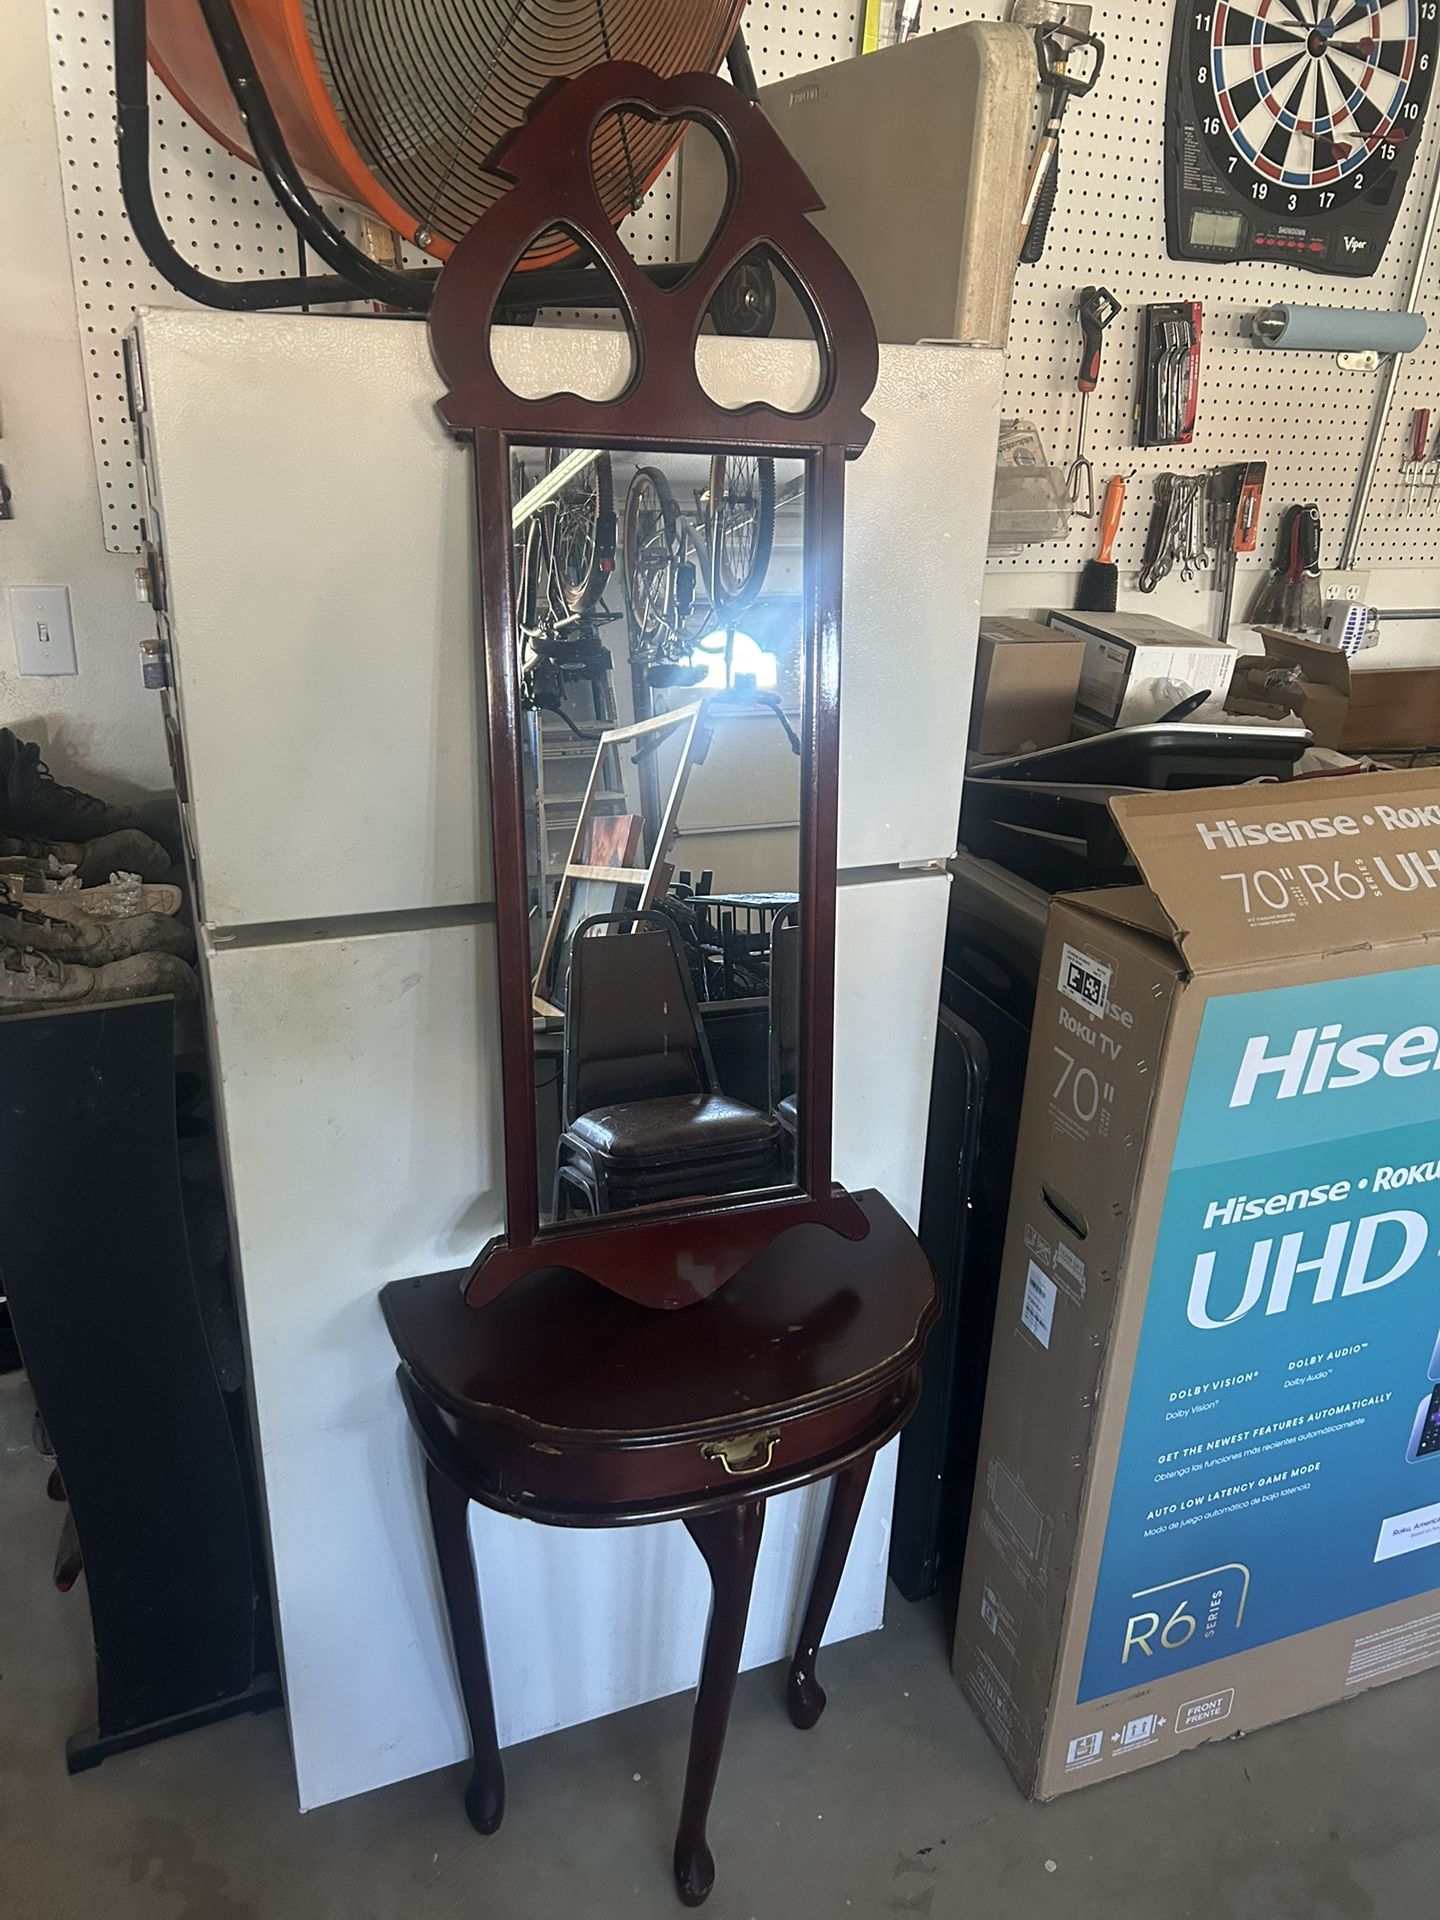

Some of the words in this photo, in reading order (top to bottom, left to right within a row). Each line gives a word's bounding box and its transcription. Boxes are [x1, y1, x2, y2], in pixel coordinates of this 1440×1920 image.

[1421, 2, 1436, 20] 13
[1195, 13, 1211, 31] 11
[1420, 54, 1429, 71] 6
[1197, 66, 1207, 84] 8
[1403, 102, 1419, 120] 10
[1203, 117, 1220, 135] 16
[1381, 142, 1396, 160] 15
[1227, 156, 1238, 173] 7
[1354, 173, 1364, 190] 2
[1251, 182, 1268, 200] 19
[1319, 192, 1335, 208] 17
[1287, 194, 1297, 211] 3
[1343, 236, 1367, 254] Viper
[1196, 814, 1360, 850] Hisense
[1374, 805, 1440, 831] Rok
[1298, 860, 1366, 904] R6
[1355, 858, 1383, 897] SERIES
[1100, 1032, 1122, 1061] TV
[1229, 1023, 1440, 1108] Hise
[1203, 1179, 1351, 1229] Hisense
[1187, 1210, 1428, 1330] UHD
[1288, 1353, 1324, 1371] DOLBY
[1284, 1377, 1306, 1389] Dolby
[1169, 1383, 1210, 1402] DOLBY
[1165, 1408, 1190, 1421] Dolby
[1158, 1451, 1180, 1465] GET
[1183, 1444, 1203, 1457] THE
[1206, 1431, 1250, 1451] NEWEST
[1252, 1416, 1304, 1438] FEATURES
[1307, 1391, 1392, 1423] AUTOMATICALLY
[1154, 1466, 1190, 1483] Obtenga
[1191, 1462, 1203, 1472] las
[1204, 1450, 1242, 1469] funciones
[1243, 1445, 1261, 1457] más
[1261, 1436, 1297, 1452] recientes
[1297, 1417, 1366, 1442] automáticamente
[1146, 1504, 1177, 1520] AUTO
[1180, 1496, 1205, 1510] LOW
[1207, 1481, 1255, 1502] LATENCY
[1257, 1471, 1288, 1487] GAME
[1290, 1462, 1321, 1478] MODE
[1143, 1525, 1168, 1538] Modo
[1168, 1521, 1180, 1530] de
[1179, 1514, 1203, 1529] juego
[1203, 1501, 1250, 1520] automático
[1250, 1496, 1261, 1506] de
[1261, 1491, 1280, 1503] baja
[1280, 1482, 1311, 1497] latencia
[1121, 1600, 1197, 1664] R6
[1204, 1589, 1223, 1639] SERIES
[1185, 1706, 1222, 1725] FRENTE
[1187, 1698, 1224, 1717] FRONT
